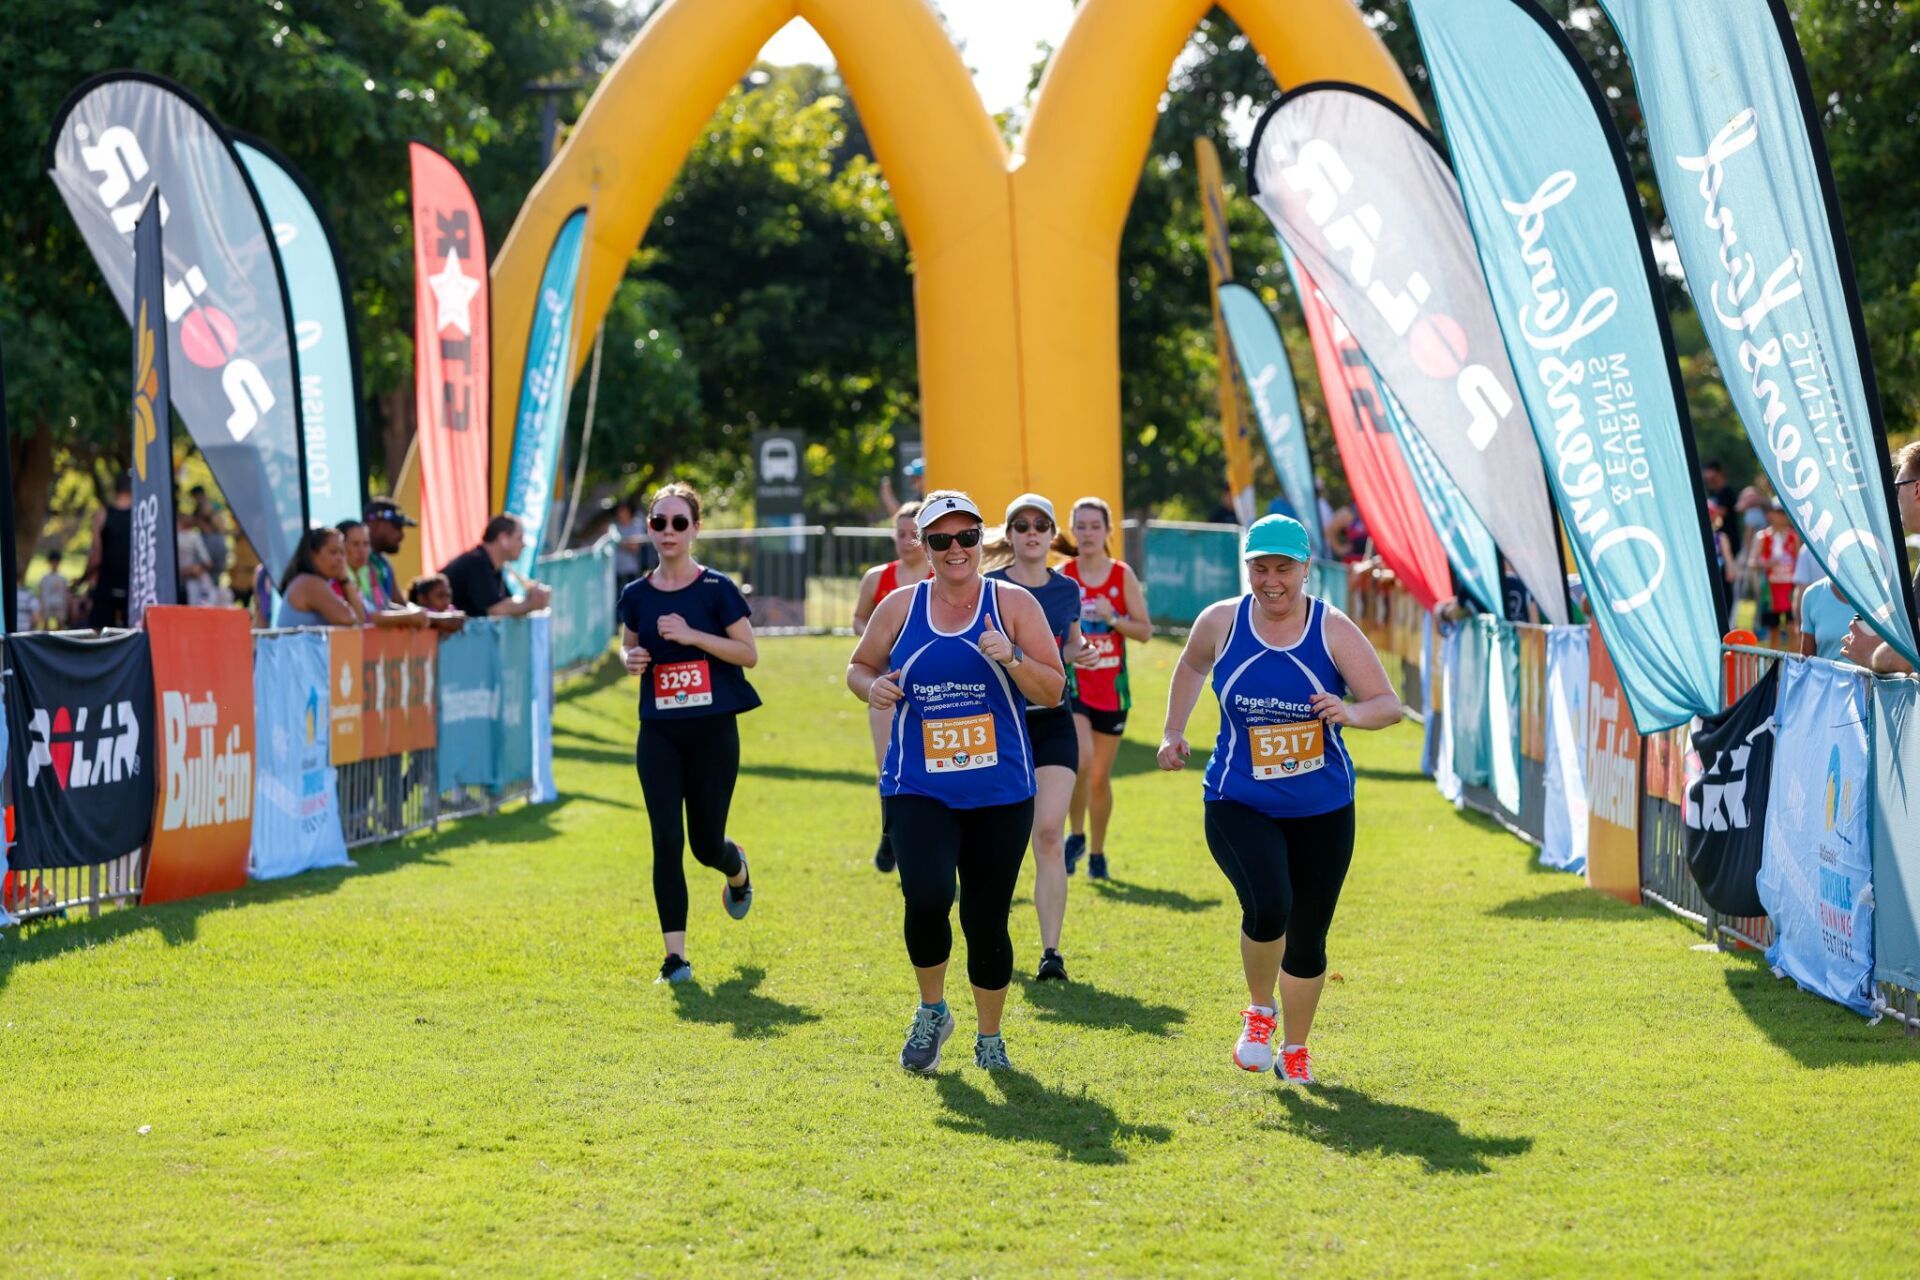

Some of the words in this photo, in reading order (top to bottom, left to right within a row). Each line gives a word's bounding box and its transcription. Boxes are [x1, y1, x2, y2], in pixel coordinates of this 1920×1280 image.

[659, 669, 703, 690] 3293
[943, 691, 969, 699] Property
[28, 700, 140, 791] POLAR
[932, 725, 987, 749] 5213
[1260, 731, 1315, 757] 5217
[162, 690, 251, 831] Bulletin
[1589, 682, 1636, 832] Bulletin
